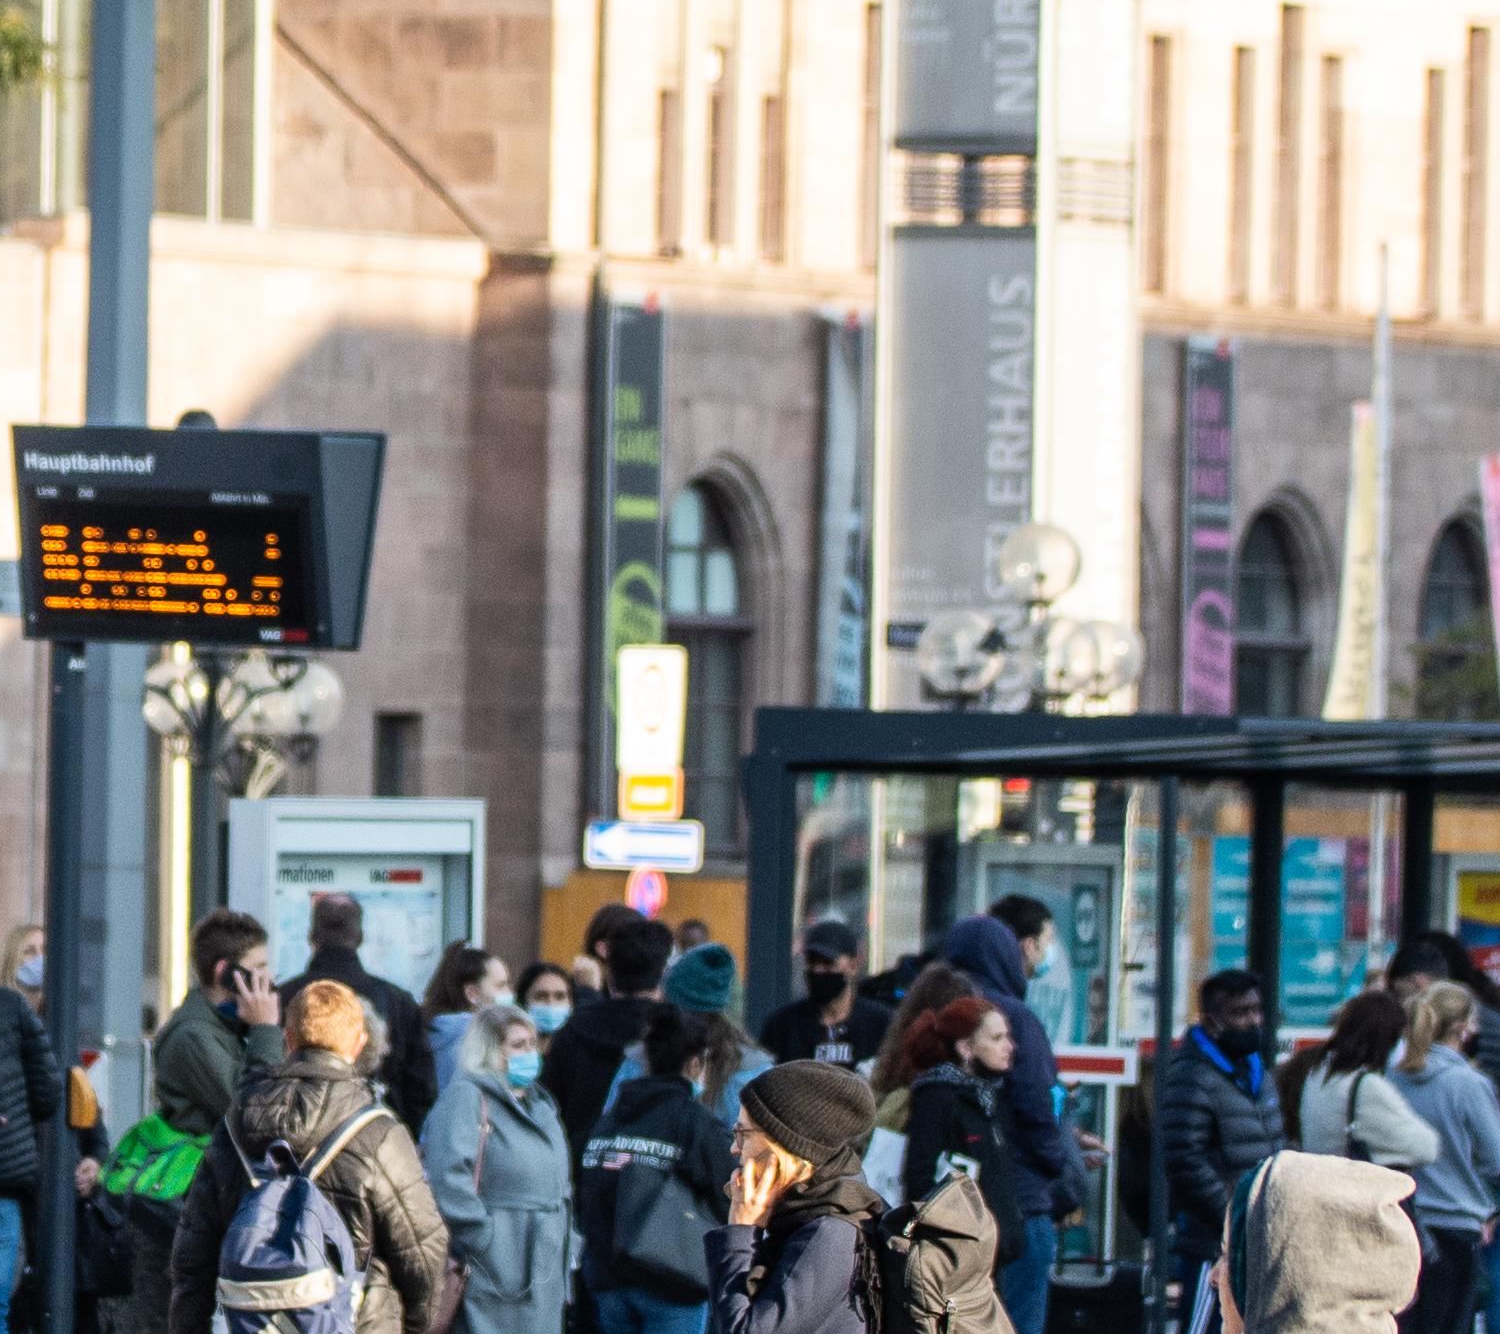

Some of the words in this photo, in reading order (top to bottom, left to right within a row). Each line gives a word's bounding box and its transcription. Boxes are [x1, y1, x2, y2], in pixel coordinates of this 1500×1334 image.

[24, 451, 154, 474] Hauptbahnhof
[984, 273, 1034, 714] NSTLERHAUS
[259, 630, 281, 641] VAG
